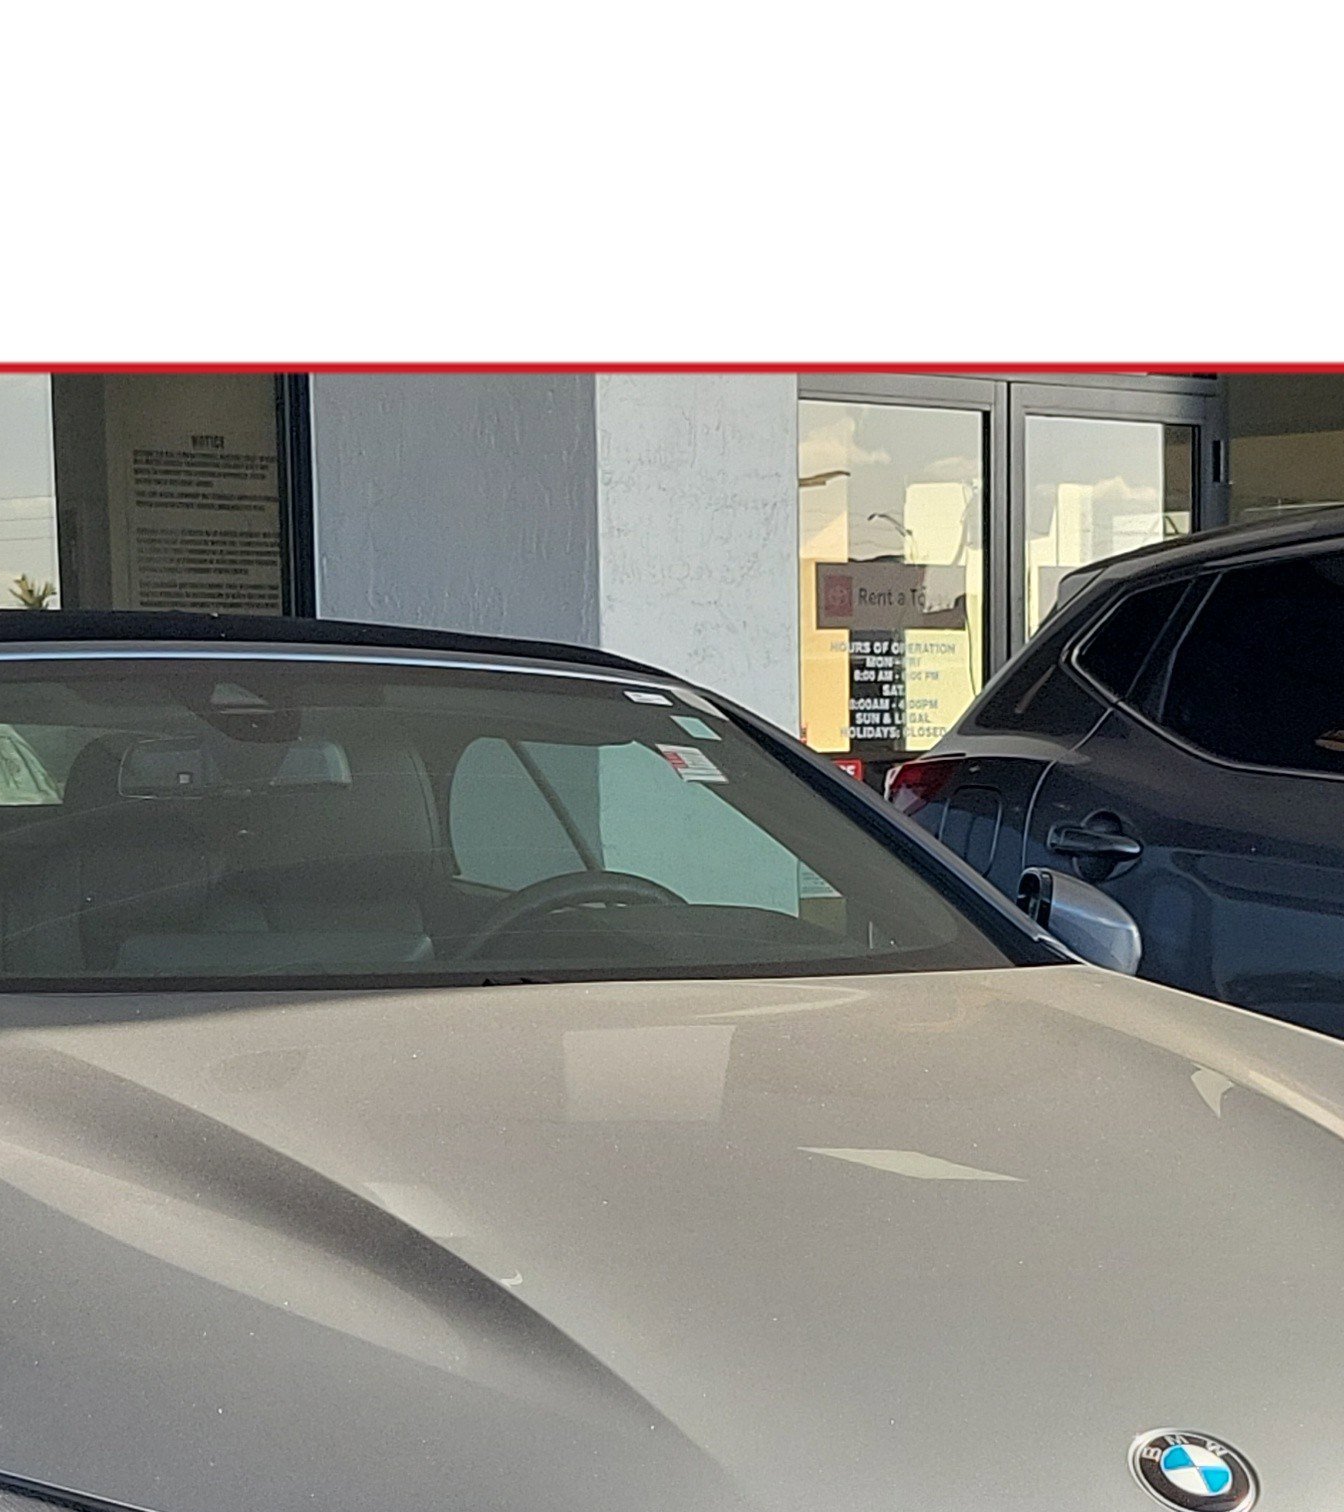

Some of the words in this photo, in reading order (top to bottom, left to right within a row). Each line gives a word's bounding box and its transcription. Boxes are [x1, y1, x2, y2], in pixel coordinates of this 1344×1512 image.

[858, 587, 893, 606] Rent
[897, 592, 906, 606] a
[830, 641, 871, 654] HOURS
[873, 641, 890, 654] OF
[866, 655, 894, 668] MON
[877, 669, 893, 682] AM
[855, 712, 880, 724] SUN
[882, 712, 891, 724] &
[1141, 1434, 1229, 1463] BMW
